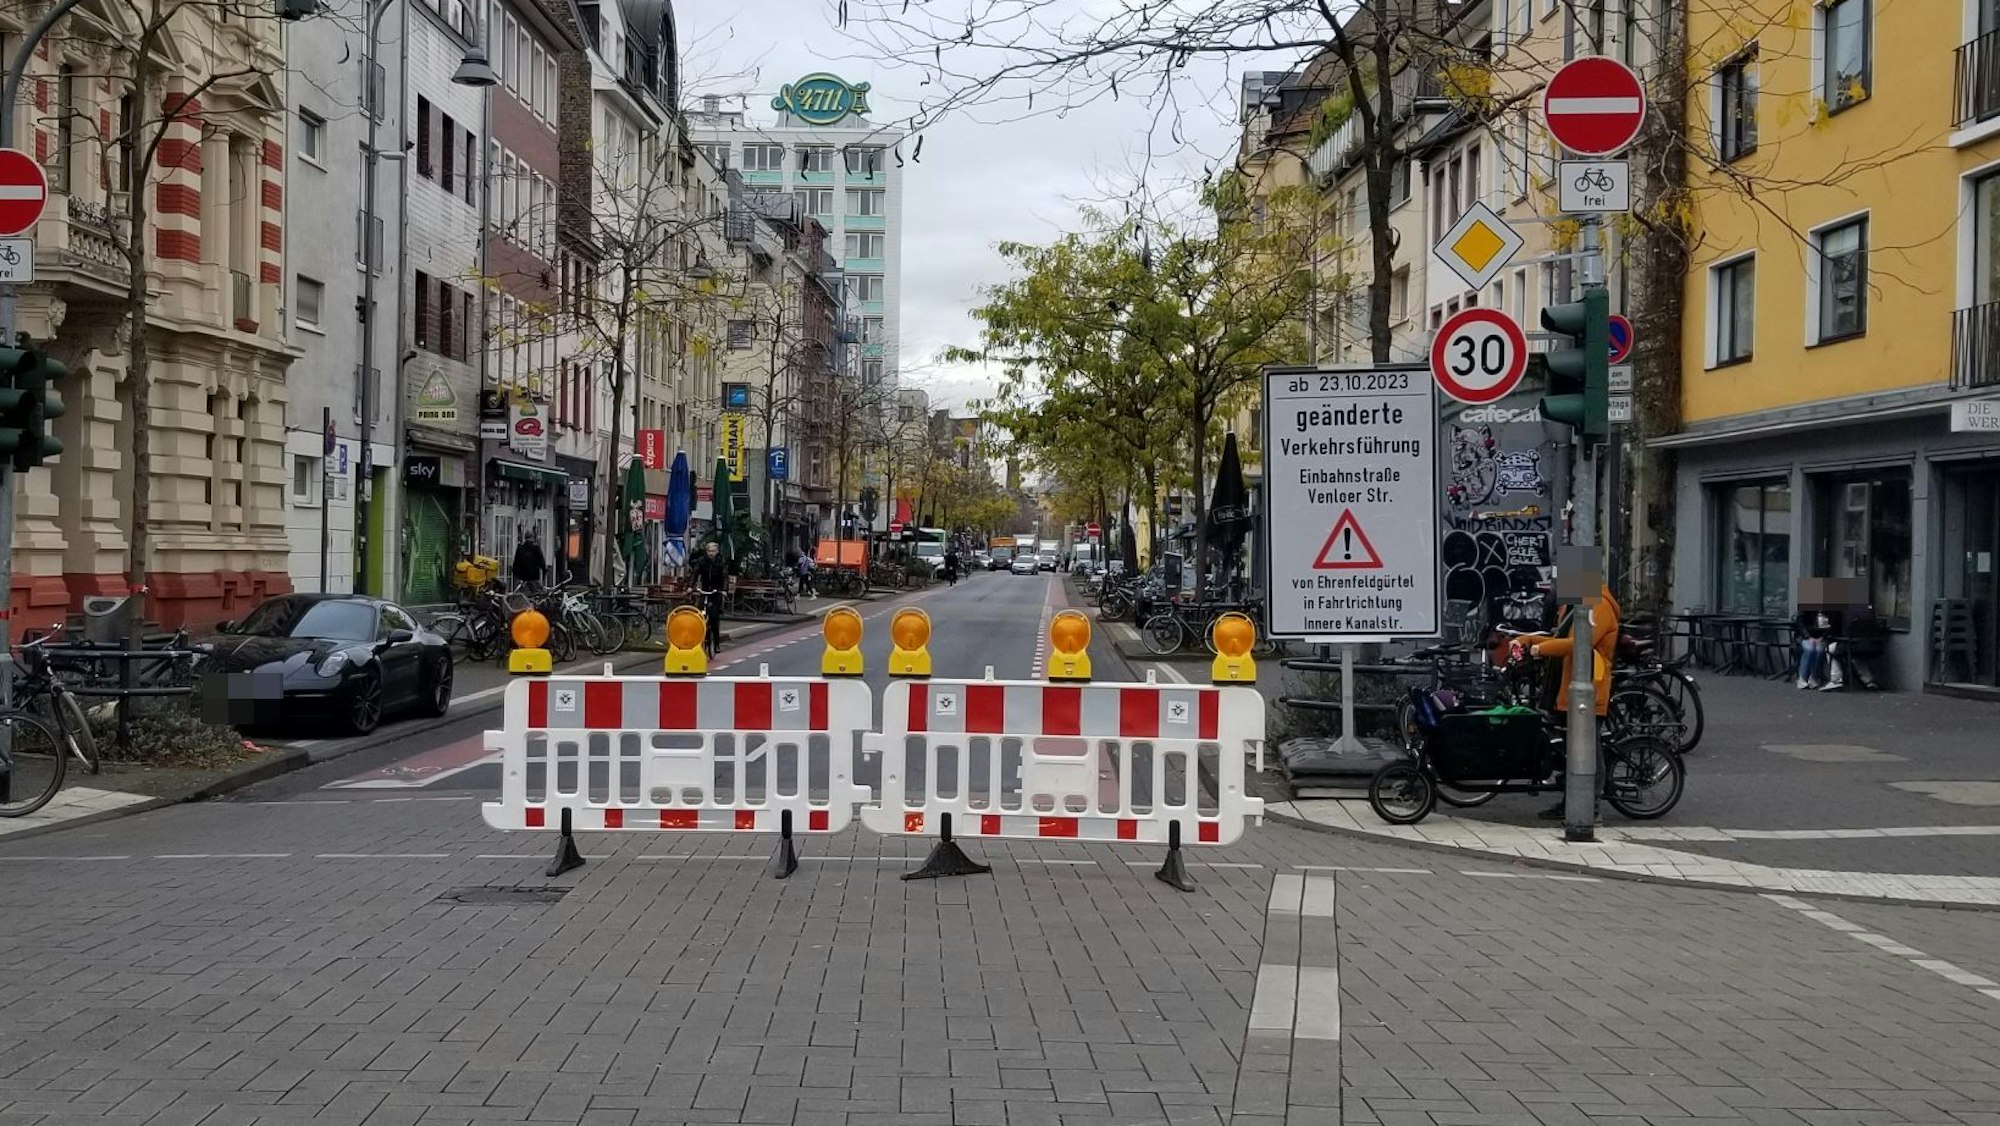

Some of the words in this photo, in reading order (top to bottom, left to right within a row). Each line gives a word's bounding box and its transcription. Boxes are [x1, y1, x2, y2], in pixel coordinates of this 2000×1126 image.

[1584, 194, 1606, 206] frei
[0, 267, 13, 278] rei
[1452, 334, 1505, 376] 30
[1288, 377, 1309, 392] ab
[1319, 374, 1409, 391] 23.10.2023
[1296, 402, 1403, 432] geänderte
[1968, 402, 1991, 415] DIE
[728, 419, 738, 476] ZEEMAN
[1280, 436, 1420, 457] Verkehrsführung
[410, 462, 435, 479] sky
[1300, 467, 1401, 485] Einbahnstraße
[1308, 488, 1362, 504] Venloer
[1367, 487, 1393, 503] Str.
[1292, 578, 1314, 589] von
[1317, 574, 1414, 591] Ehrenfeldgürtel
[1303, 596, 1314, 610] in
[1318, 594, 1403, 611] Fahrtrichtung
[1304, 616, 1342, 630] Innere
[1345, 615, 1403, 629] Kanalstr.
